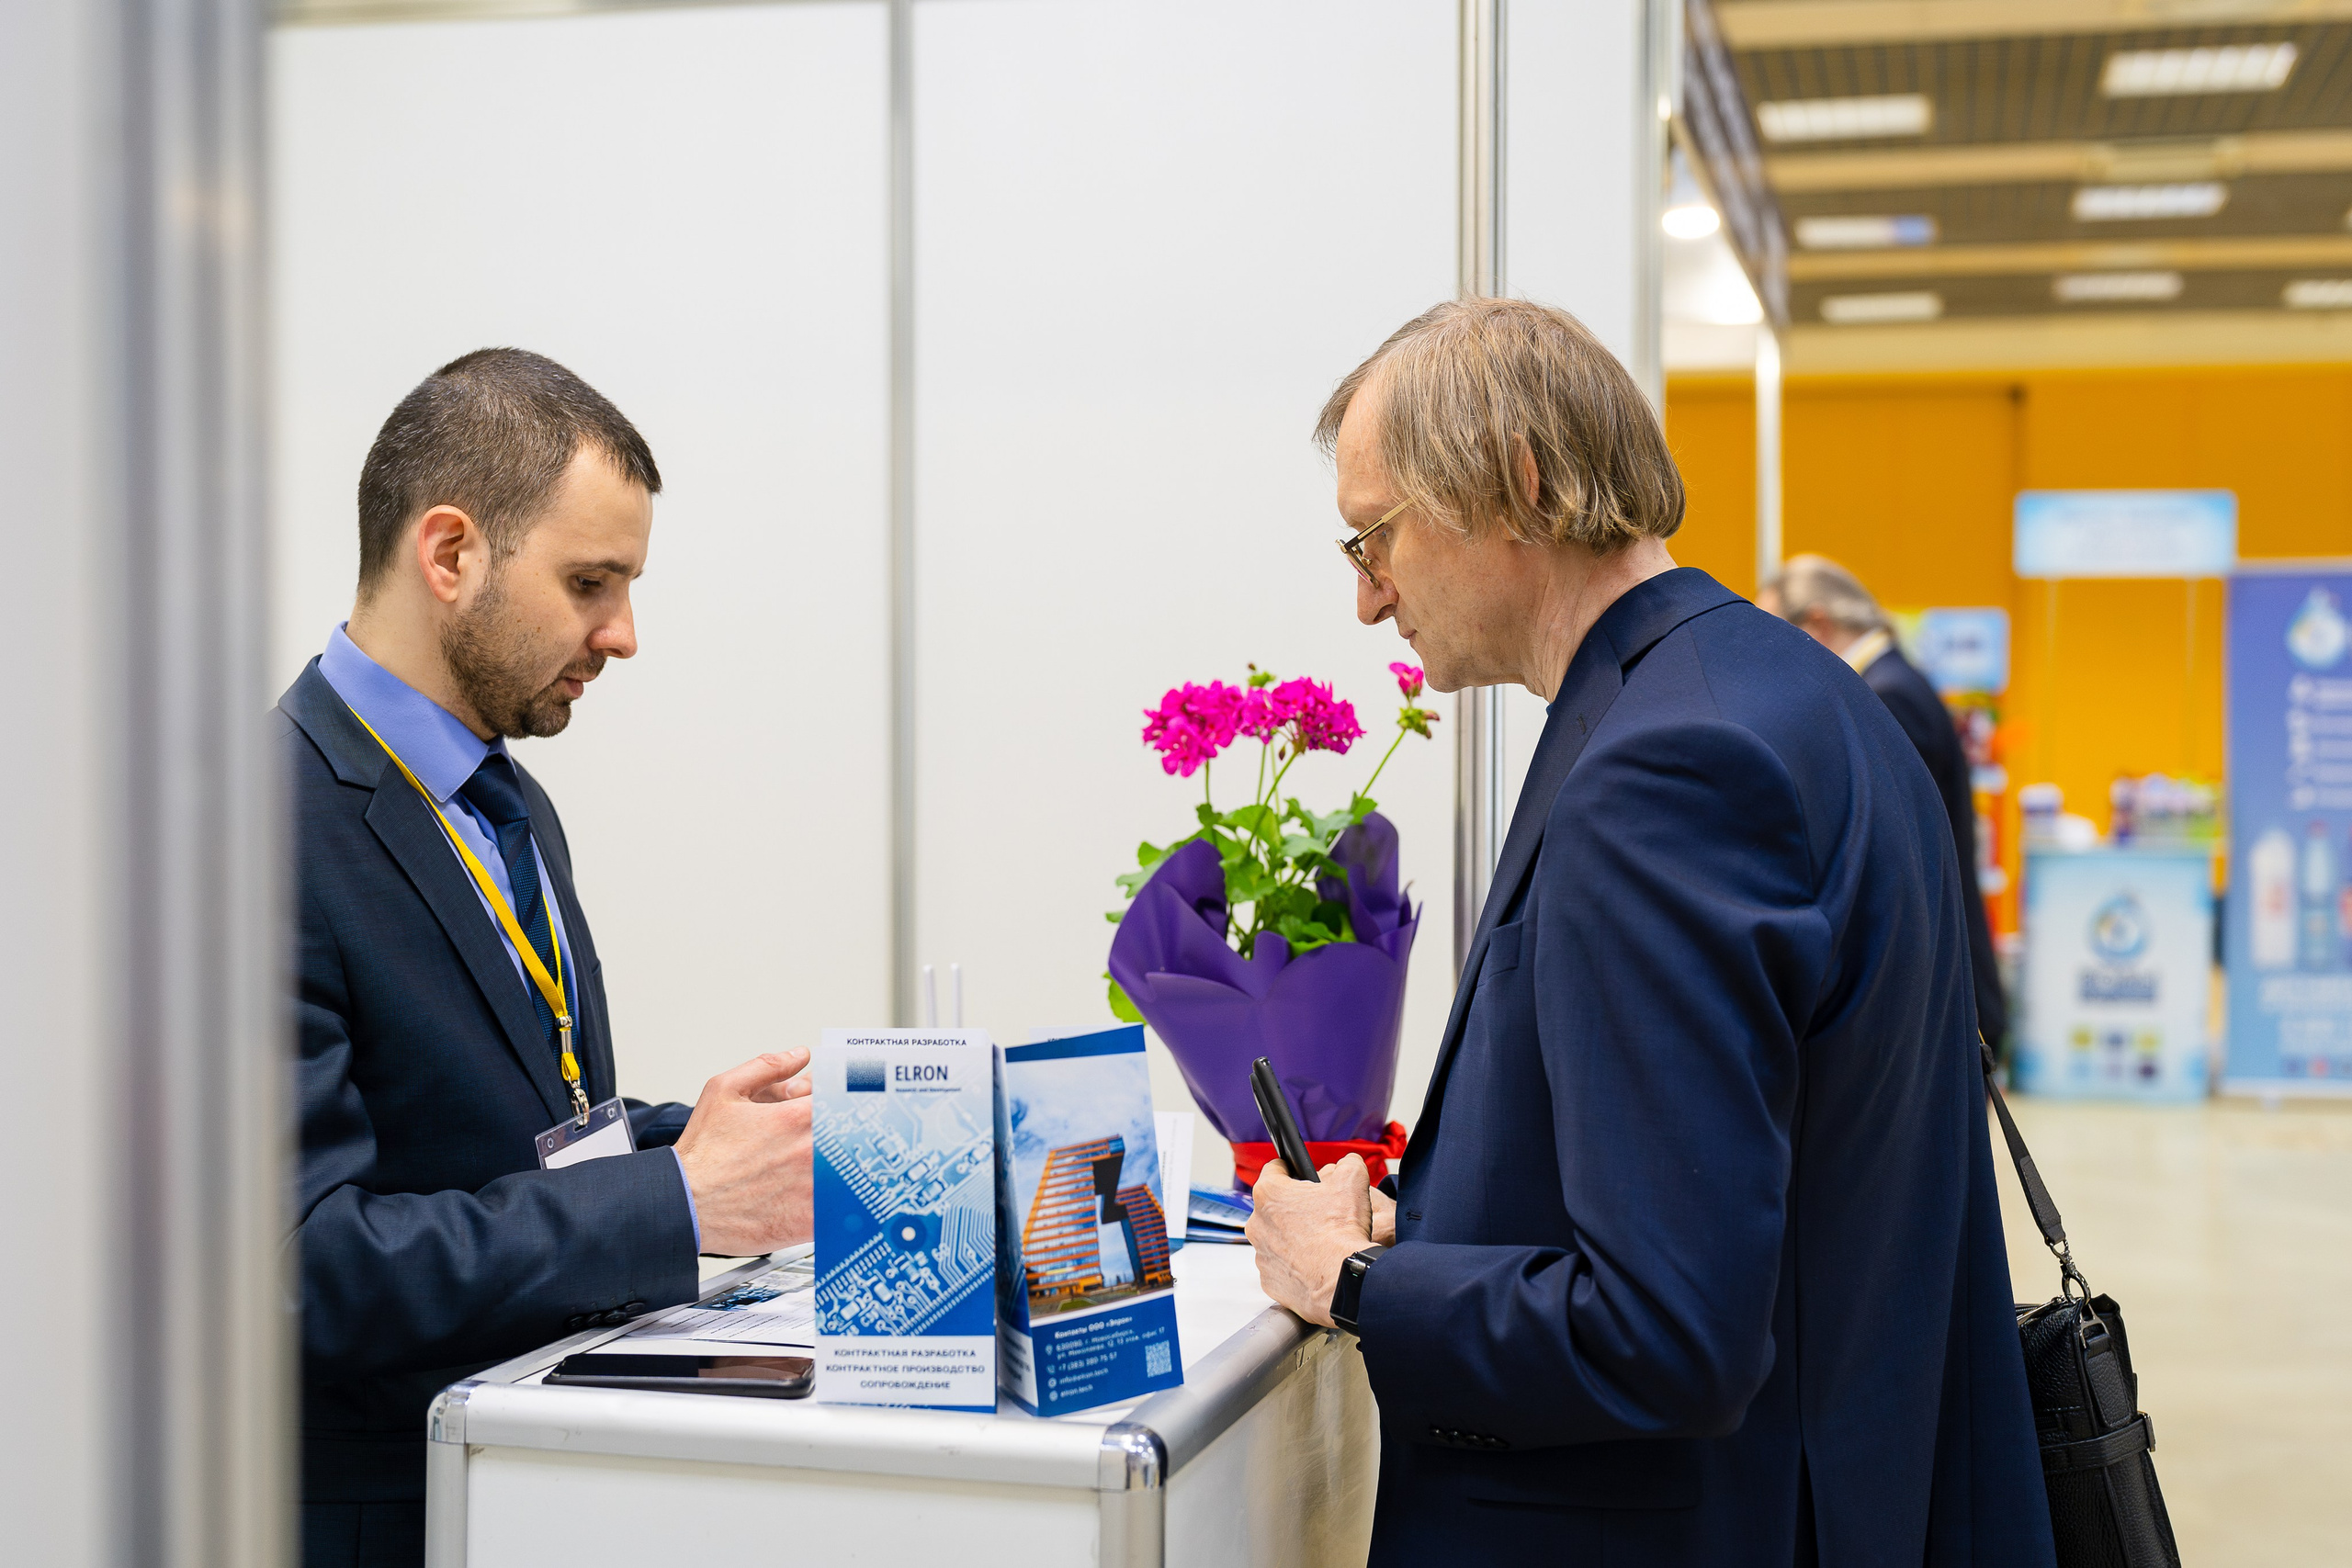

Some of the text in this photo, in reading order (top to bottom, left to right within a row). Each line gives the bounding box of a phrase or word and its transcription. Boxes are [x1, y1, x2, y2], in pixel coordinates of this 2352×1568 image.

[911, 1038, 967, 1046] РАЗРАБОТКА
[895, 1066, 948, 1081] ELRON
[902, 1365, 985, 1373] ПРОИЗВОДСТВО
[860, 1380, 951, 1389] СОПРОВОЖДЕНИЕ
